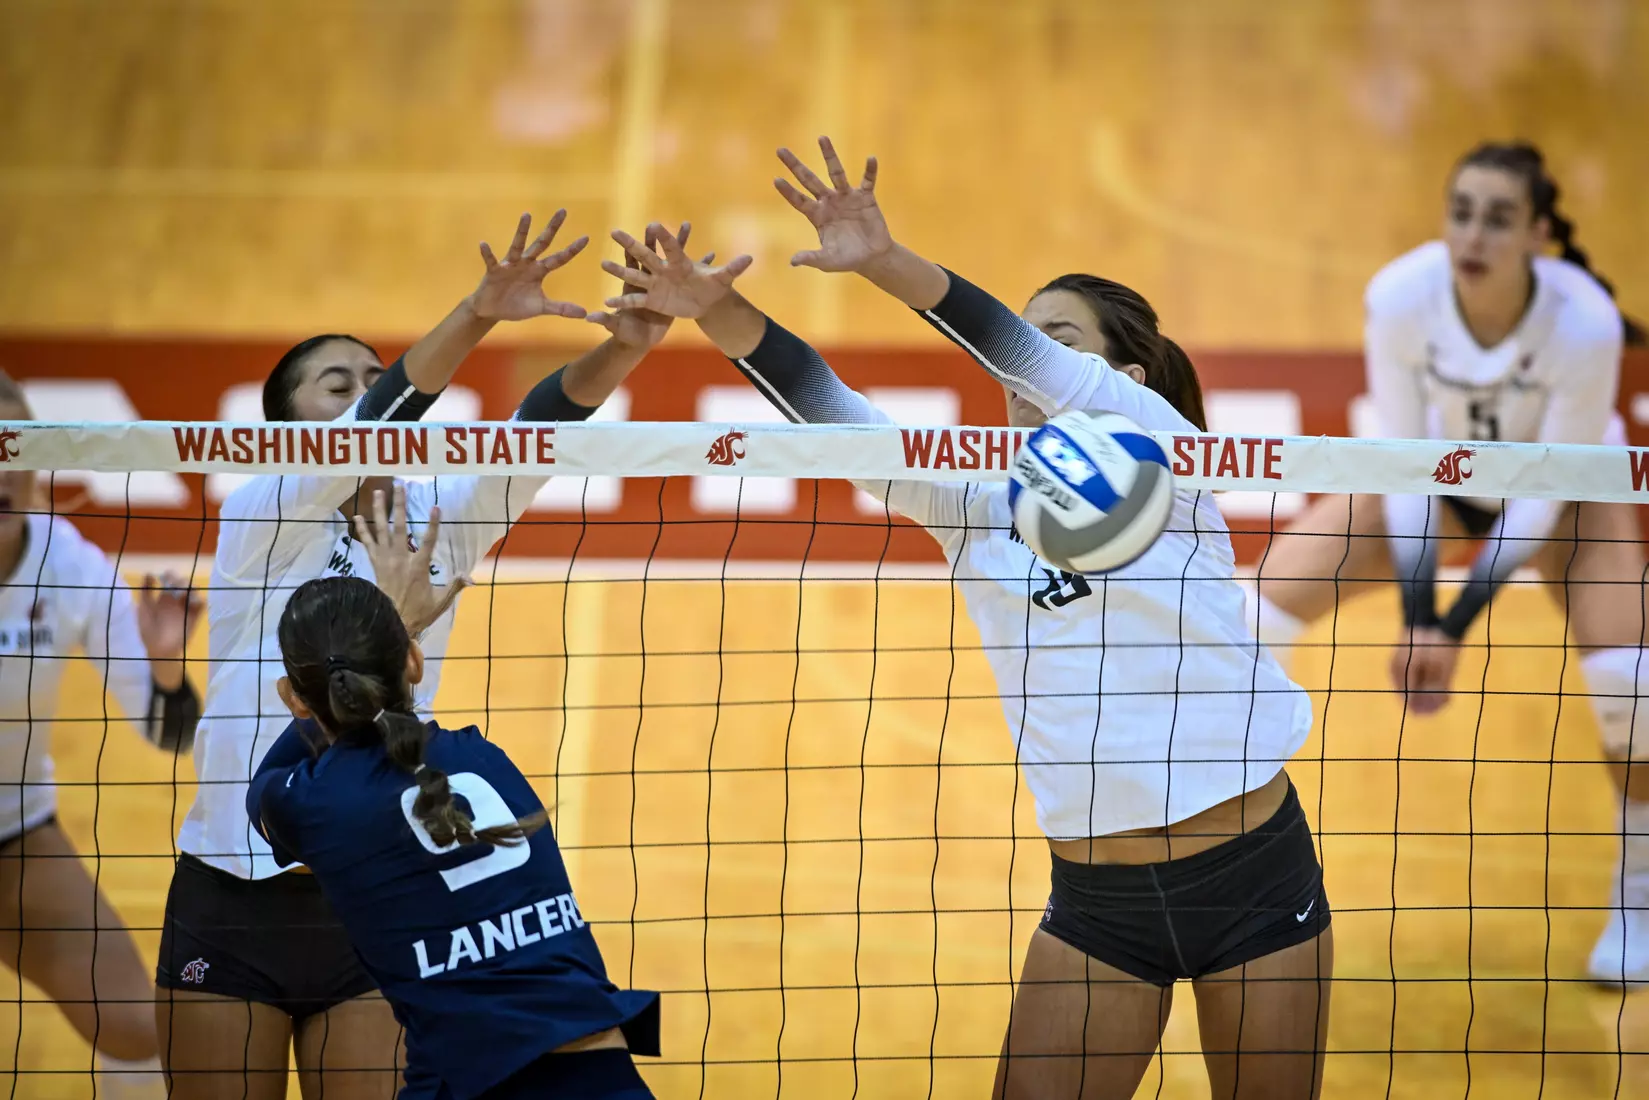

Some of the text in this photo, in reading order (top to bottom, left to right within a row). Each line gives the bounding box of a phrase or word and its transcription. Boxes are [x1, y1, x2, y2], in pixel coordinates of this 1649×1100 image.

[173, 427, 556, 465] WASHINGTON STATE
[1172, 435, 1284, 480] STATE
